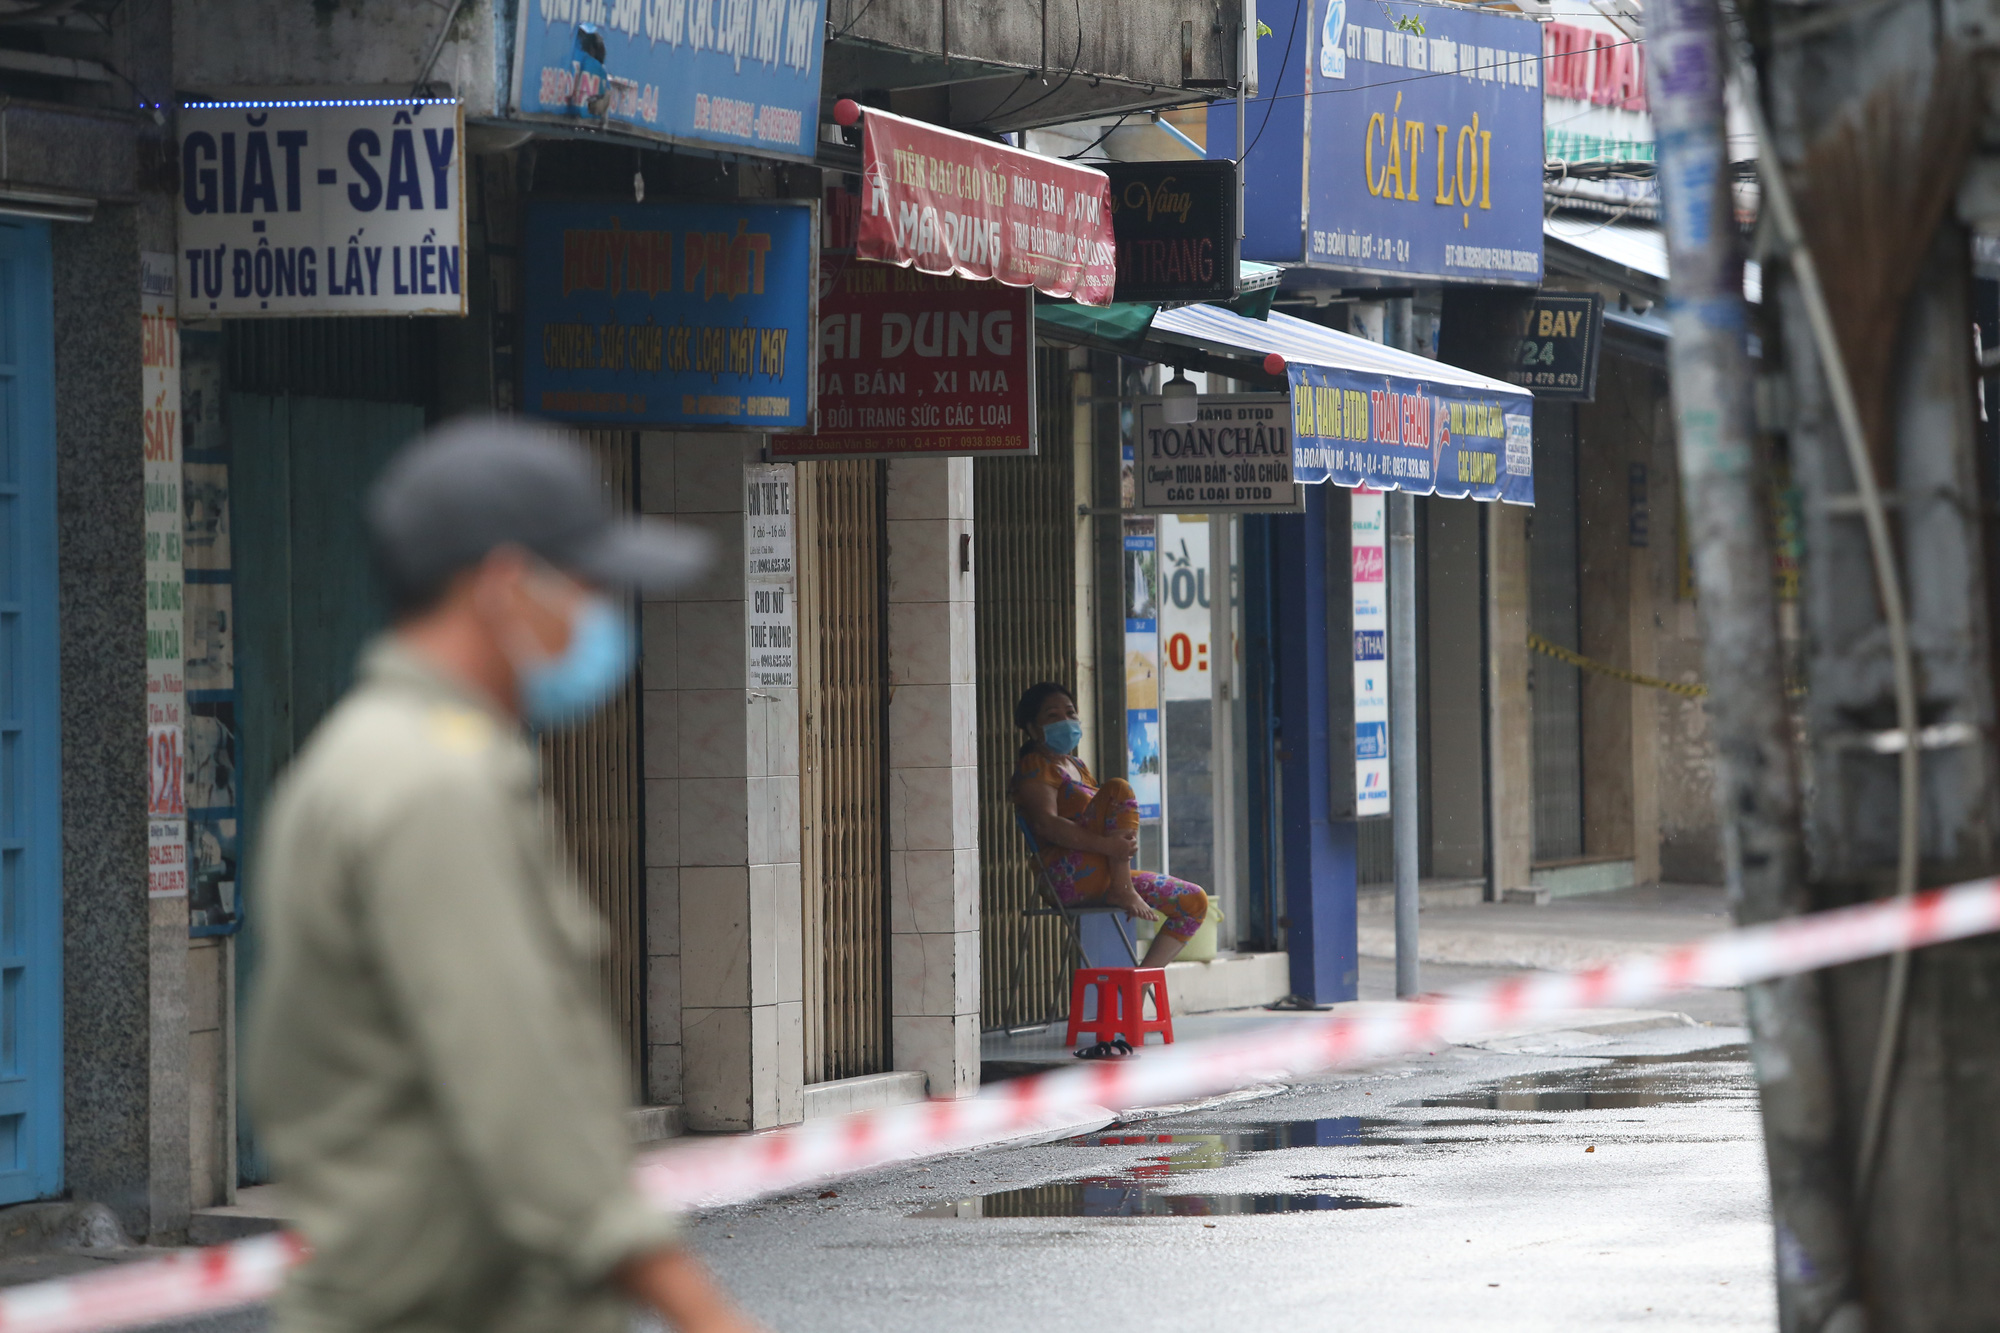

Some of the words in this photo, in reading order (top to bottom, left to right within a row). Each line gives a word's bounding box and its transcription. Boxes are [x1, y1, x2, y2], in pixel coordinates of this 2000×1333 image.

[183, 112, 308, 232] GIẶT
[347, 106, 455, 213] SẤY
[894, 145, 926, 191] TIỆM
[930, 153, 954, 200] BẠC
[957, 161, 981, 201] CAO
[985, 163, 1009, 207] CẤP
[1366, 90, 1424, 201] CÁT
[1435, 111, 1491, 229] LỢI
[1014, 175, 1038, 209] MUA
[1042, 181, 1064, 216] BÁN
[1074, 191, 1084, 221] XI
[945, 211, 1002, 269] DUNG
[1031, 216, 1045, 253] ĐỔI
[1045, 228, 1065, 259] TRANG
[1327, 227, 1346, 257] ĐOÀN
[1347, 229, 1361, 258] VĂN
[1361, 233, 1373, 259] BƠ
[1378, 238, 1391, 261] P.10
[1397, 239, 1410, 262] Q.4
[186, 243, 226, 309] TỰ
[233, 237, 317, 309] ĐỘNG
[328, 228, 382, 296] LẤY
[394, 228, 460, 295] LIỀN
[684, 218, 771, 302] PHÁT
[1137, 238, 1213, 282] TRANG
[143, 305, 177, 381] GIẶT
[819, 313, 862, 366] AI
[881, 310, 1013, 359] DUNG
[1539, 310, 1582, 338] BAY
[667, 315, 691, 375] CÁC
[695, 326, 726, 384] LOẠI
[729, 316, 758, 381] MÁY
[759, 327, 789, 383] MAY
[854, 368, 906, 395] BÁN
[933, 371, 957, 393] XI
[968, 370, 1010, 397] MẠ
[1558, 373, 1578, 386] 470
[145, 389, 176, 461] SẤY
[827, 400, 853, 428] ĐỔI
[858, 407, 906, 428] TRANG
[911, 402, 940, 427] SỨC
[945, 402, 974, 426] CÁC
[979, 404, 1012, 429] LOẠI
[1197, 406, 1231, 420] HÀNG
[1295, 369, 1315, 438] CỬA
[1316, 374, 1341, 439] HÀNG
[1371, 379, 1399, 445] TOÀN
[1402, 383, 1430, 449] CHÂU
[960, 436, 1021, 447] 0938.899.505
[1148, 423, 1217, 459] TOÀN
[1217, 421, 1289, 459] CHÂU
[1175, 465, 1200, 483] MUA
[1204, 461, 1226, 483] BÁN
[1233, 459, 1256, 483] SỬA
[1258, 460, 1288, 483] CHỮA
[1336, 448, 1345, 470] BƠ
[1350, 452, 1362, 472] P.10
[1367, 453, 1377, 475] Q.4
[748, 482, 760, 516] CHO
[762, 476, 779, 515] THUÊ
[781, 482, 789, 515] XE
[1167, 486, 1195, 501] CÁC
[1200, 487, 1230, 503] LOẠI
[755, 590, 770, 614] CHO
[773, 587, 784, 614] NỮ
[751, 621, 767, 648] THUÊ
[769, 621, 791, 648] PHÒNG
